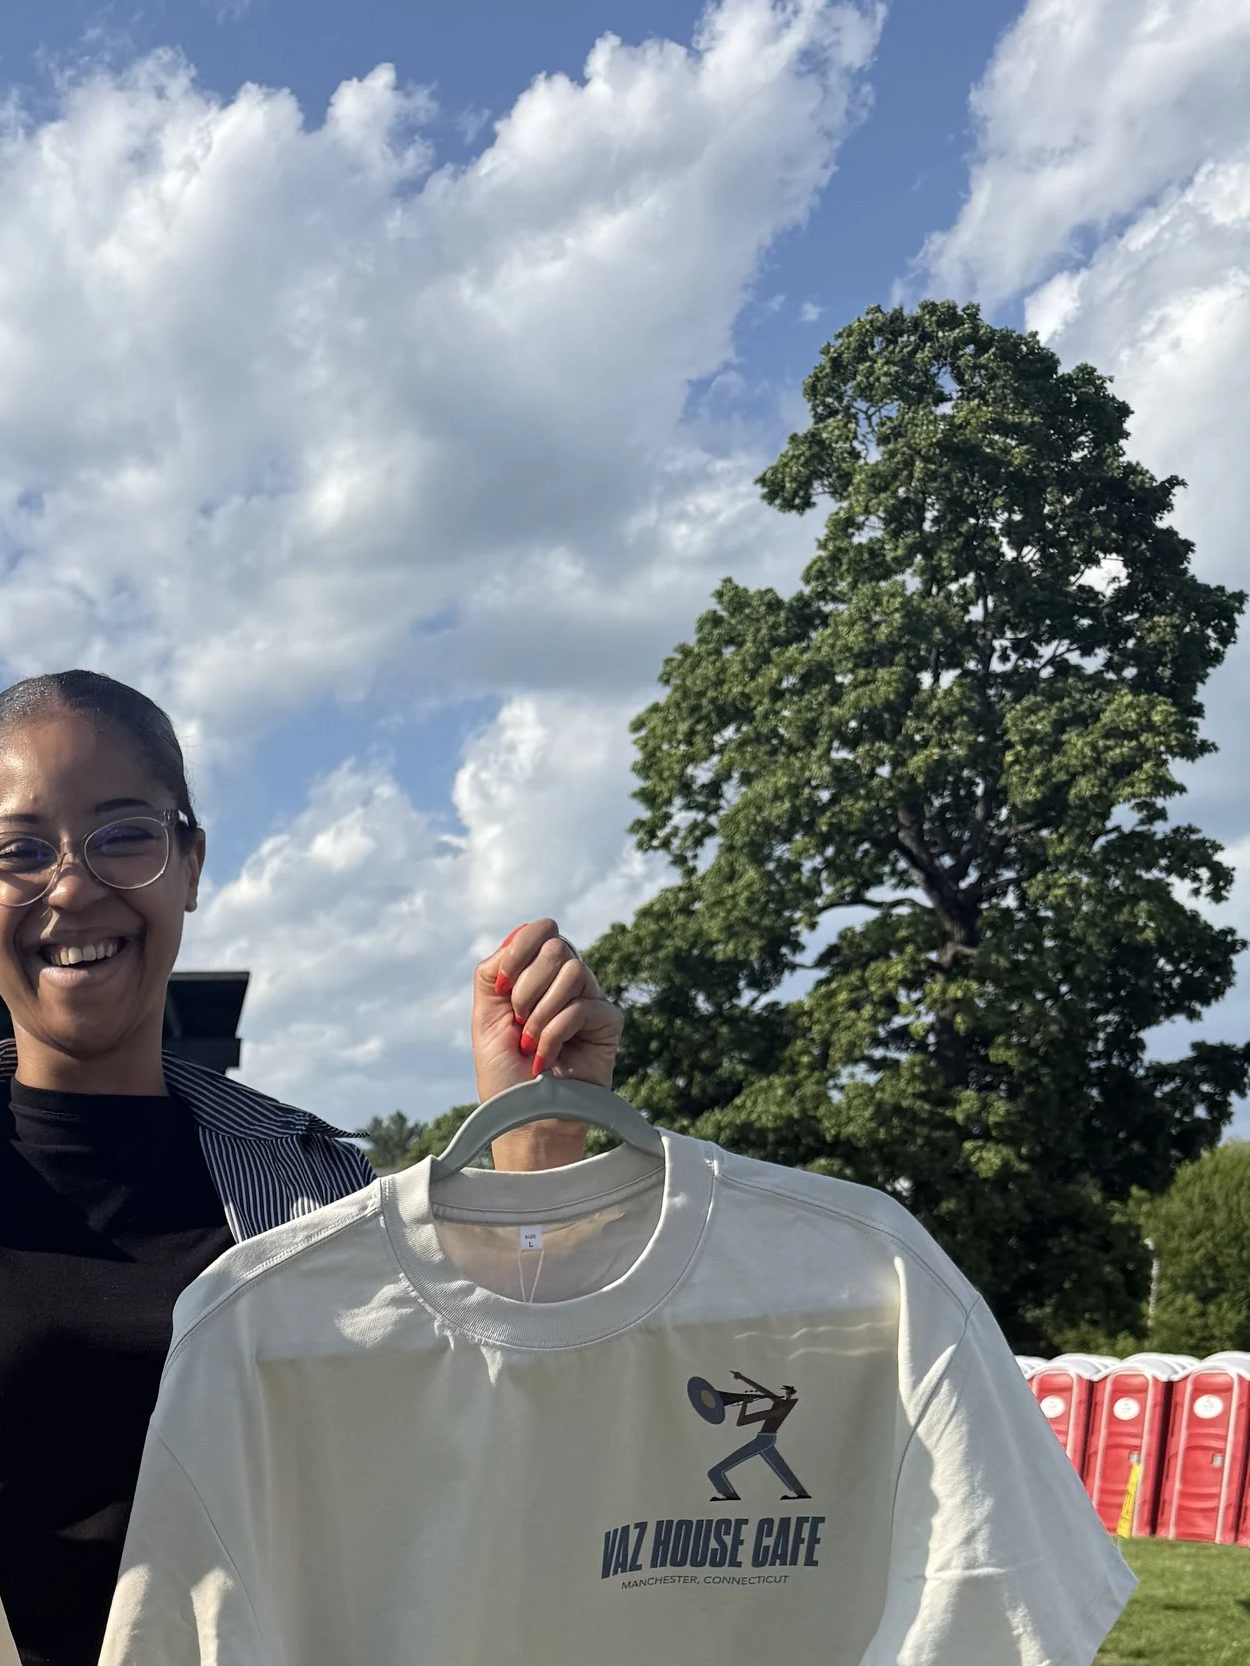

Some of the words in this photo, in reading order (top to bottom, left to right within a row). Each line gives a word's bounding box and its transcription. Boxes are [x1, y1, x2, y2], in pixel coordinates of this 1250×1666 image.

[601, 1521, 648, 1579] VAZ
[650, 1518, 749, 1568] HOUSE
[751, 1516, 826, 1568] CAFE
[621, 1575, 700, 1590] MANCHESTER,
[703, 1575, 790, 1585] CONNECTICUT
